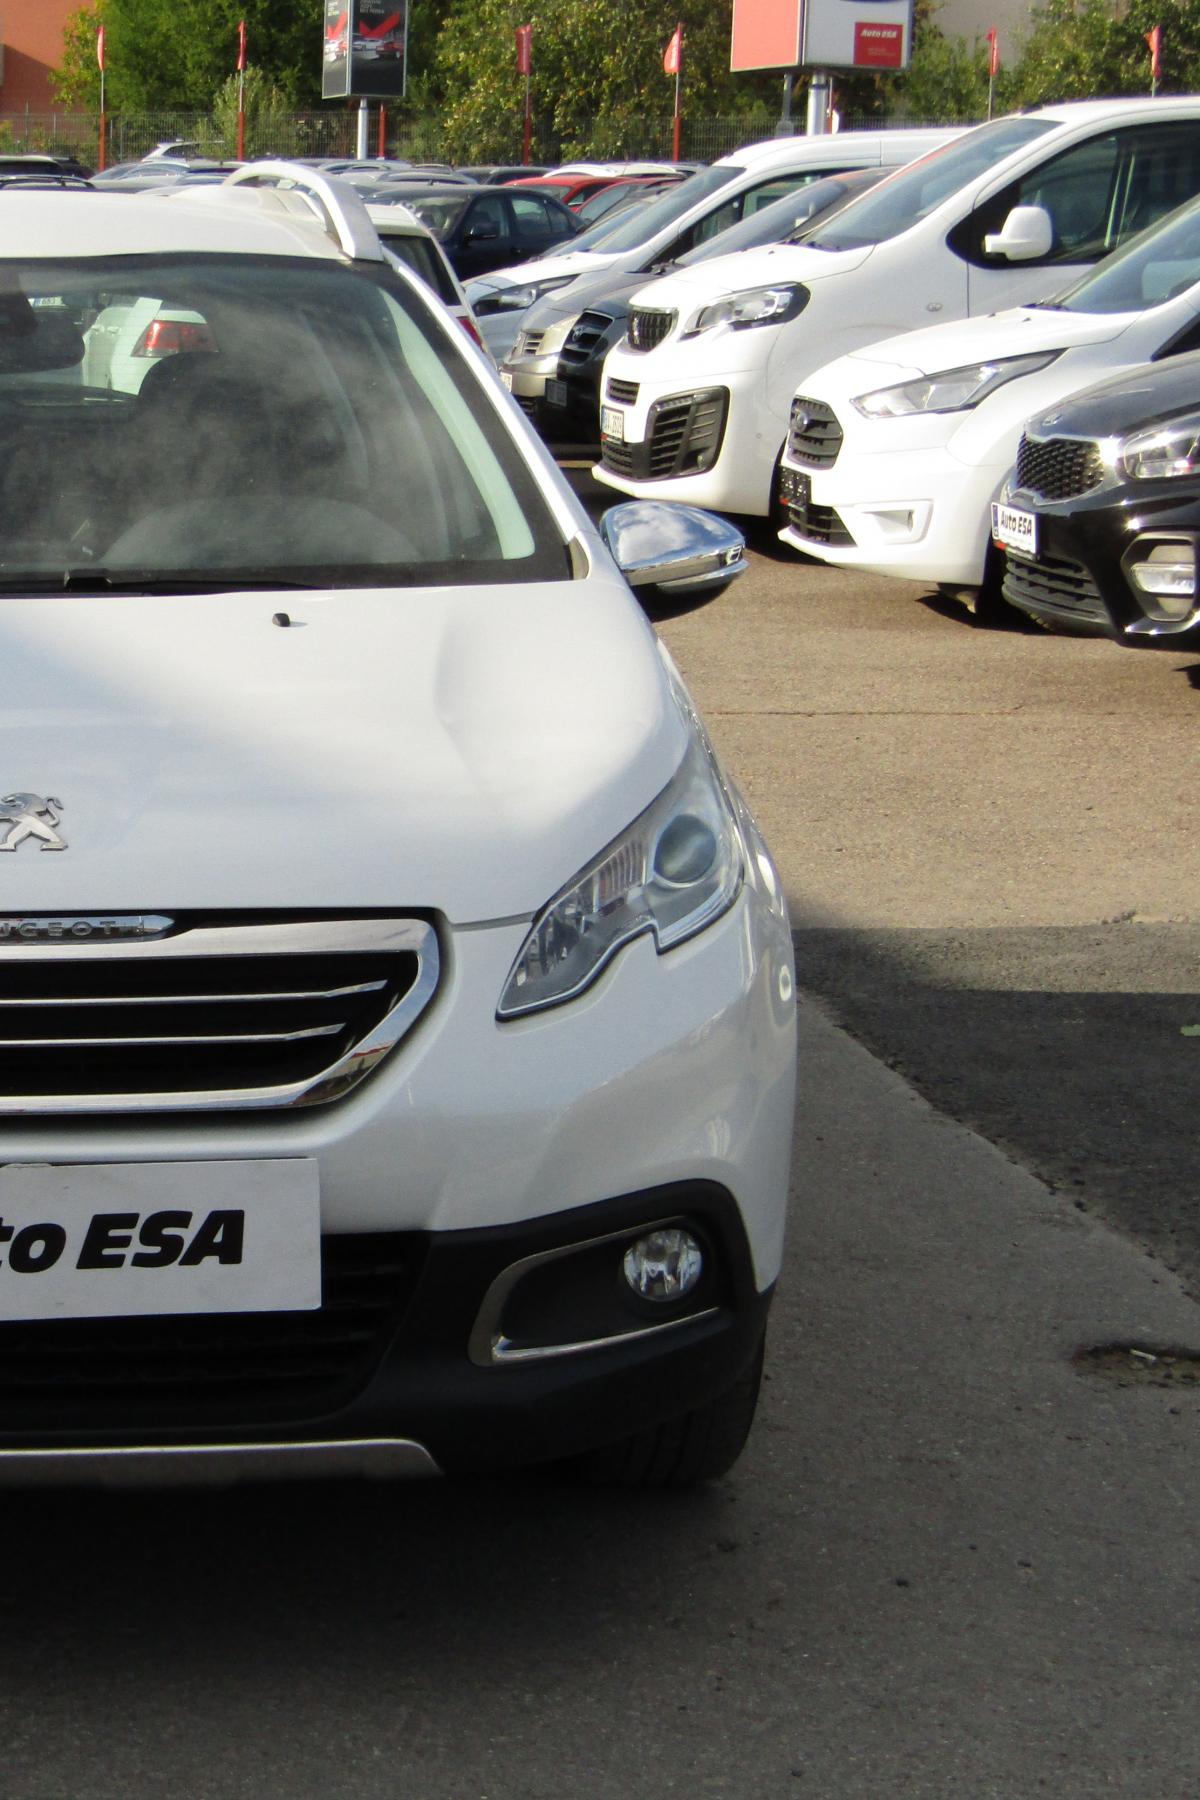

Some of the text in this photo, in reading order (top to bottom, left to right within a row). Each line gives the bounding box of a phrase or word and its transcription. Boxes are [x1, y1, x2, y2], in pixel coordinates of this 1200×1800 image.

[860, 29, 881, 38] Auto
[1000, 511, 1017, 532] Auto
[1017, 516, 1033, 537] ESA
[75, 1209, 245, 1270] ESA
